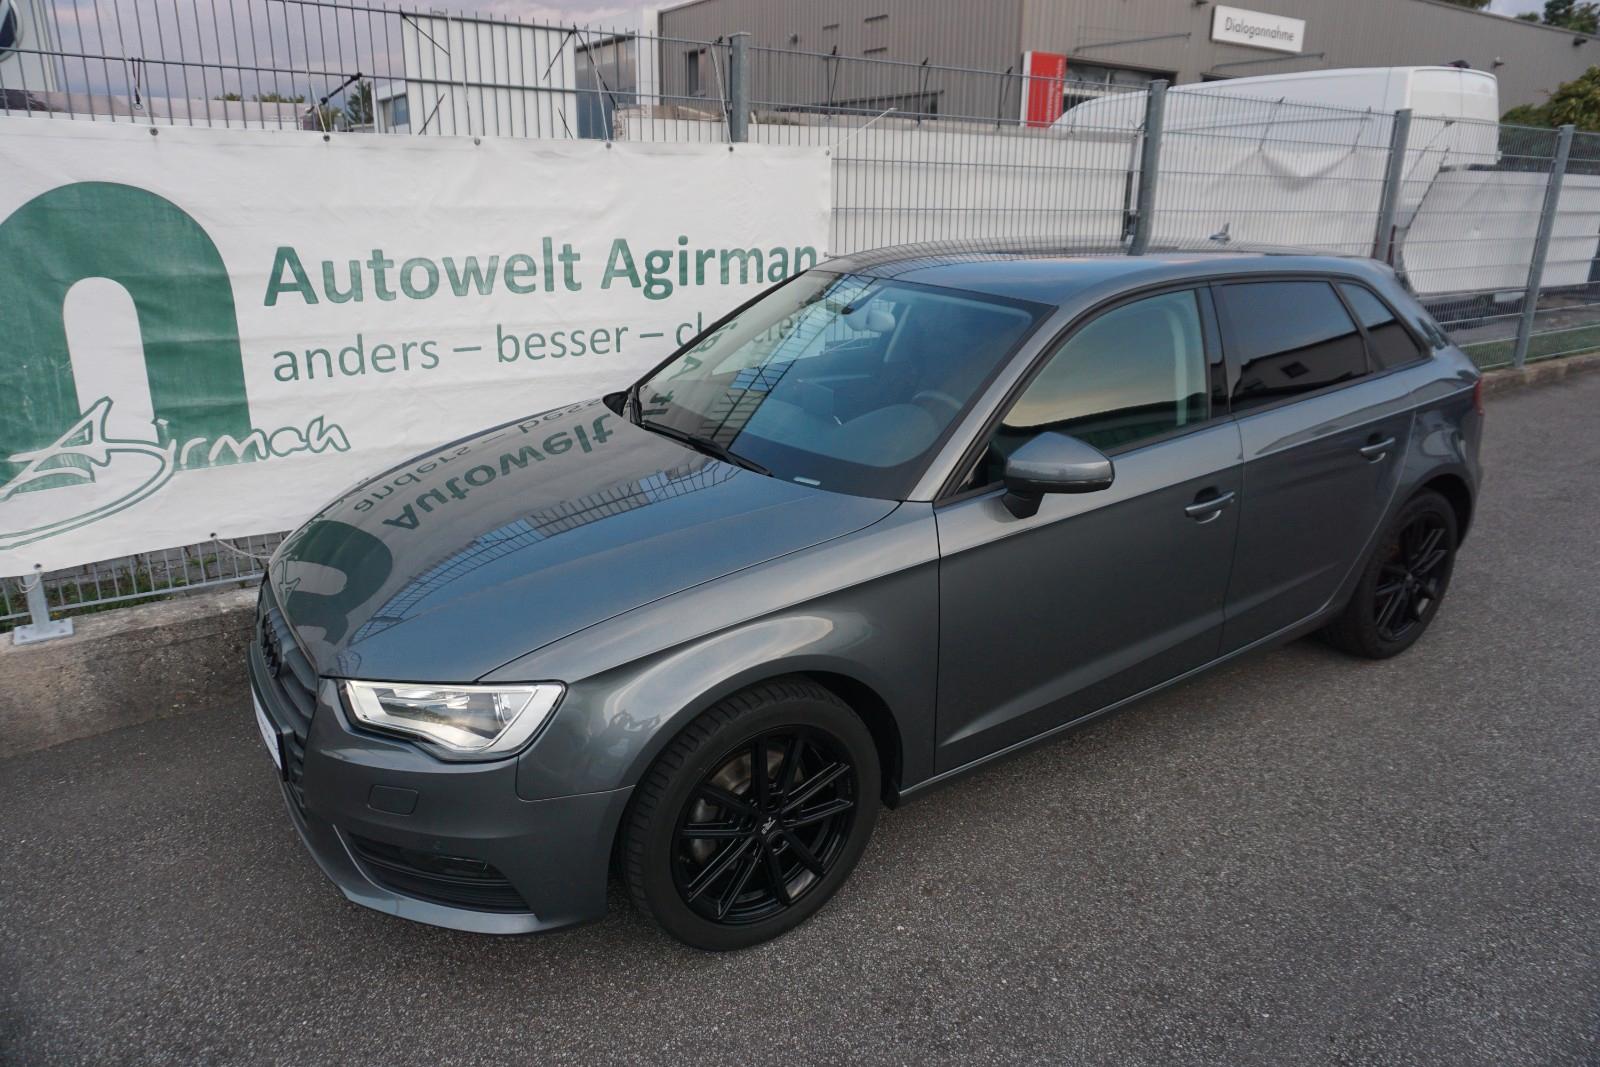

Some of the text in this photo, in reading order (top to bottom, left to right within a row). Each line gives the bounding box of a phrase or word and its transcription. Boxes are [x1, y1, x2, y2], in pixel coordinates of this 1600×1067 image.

[1224, 16, 1295, 41] Dialogannahme
[263, 235, 818, 307] Autowelt Agirman
[273, 333, 440, 382] anders
[496, 323, 630, 363] besser
